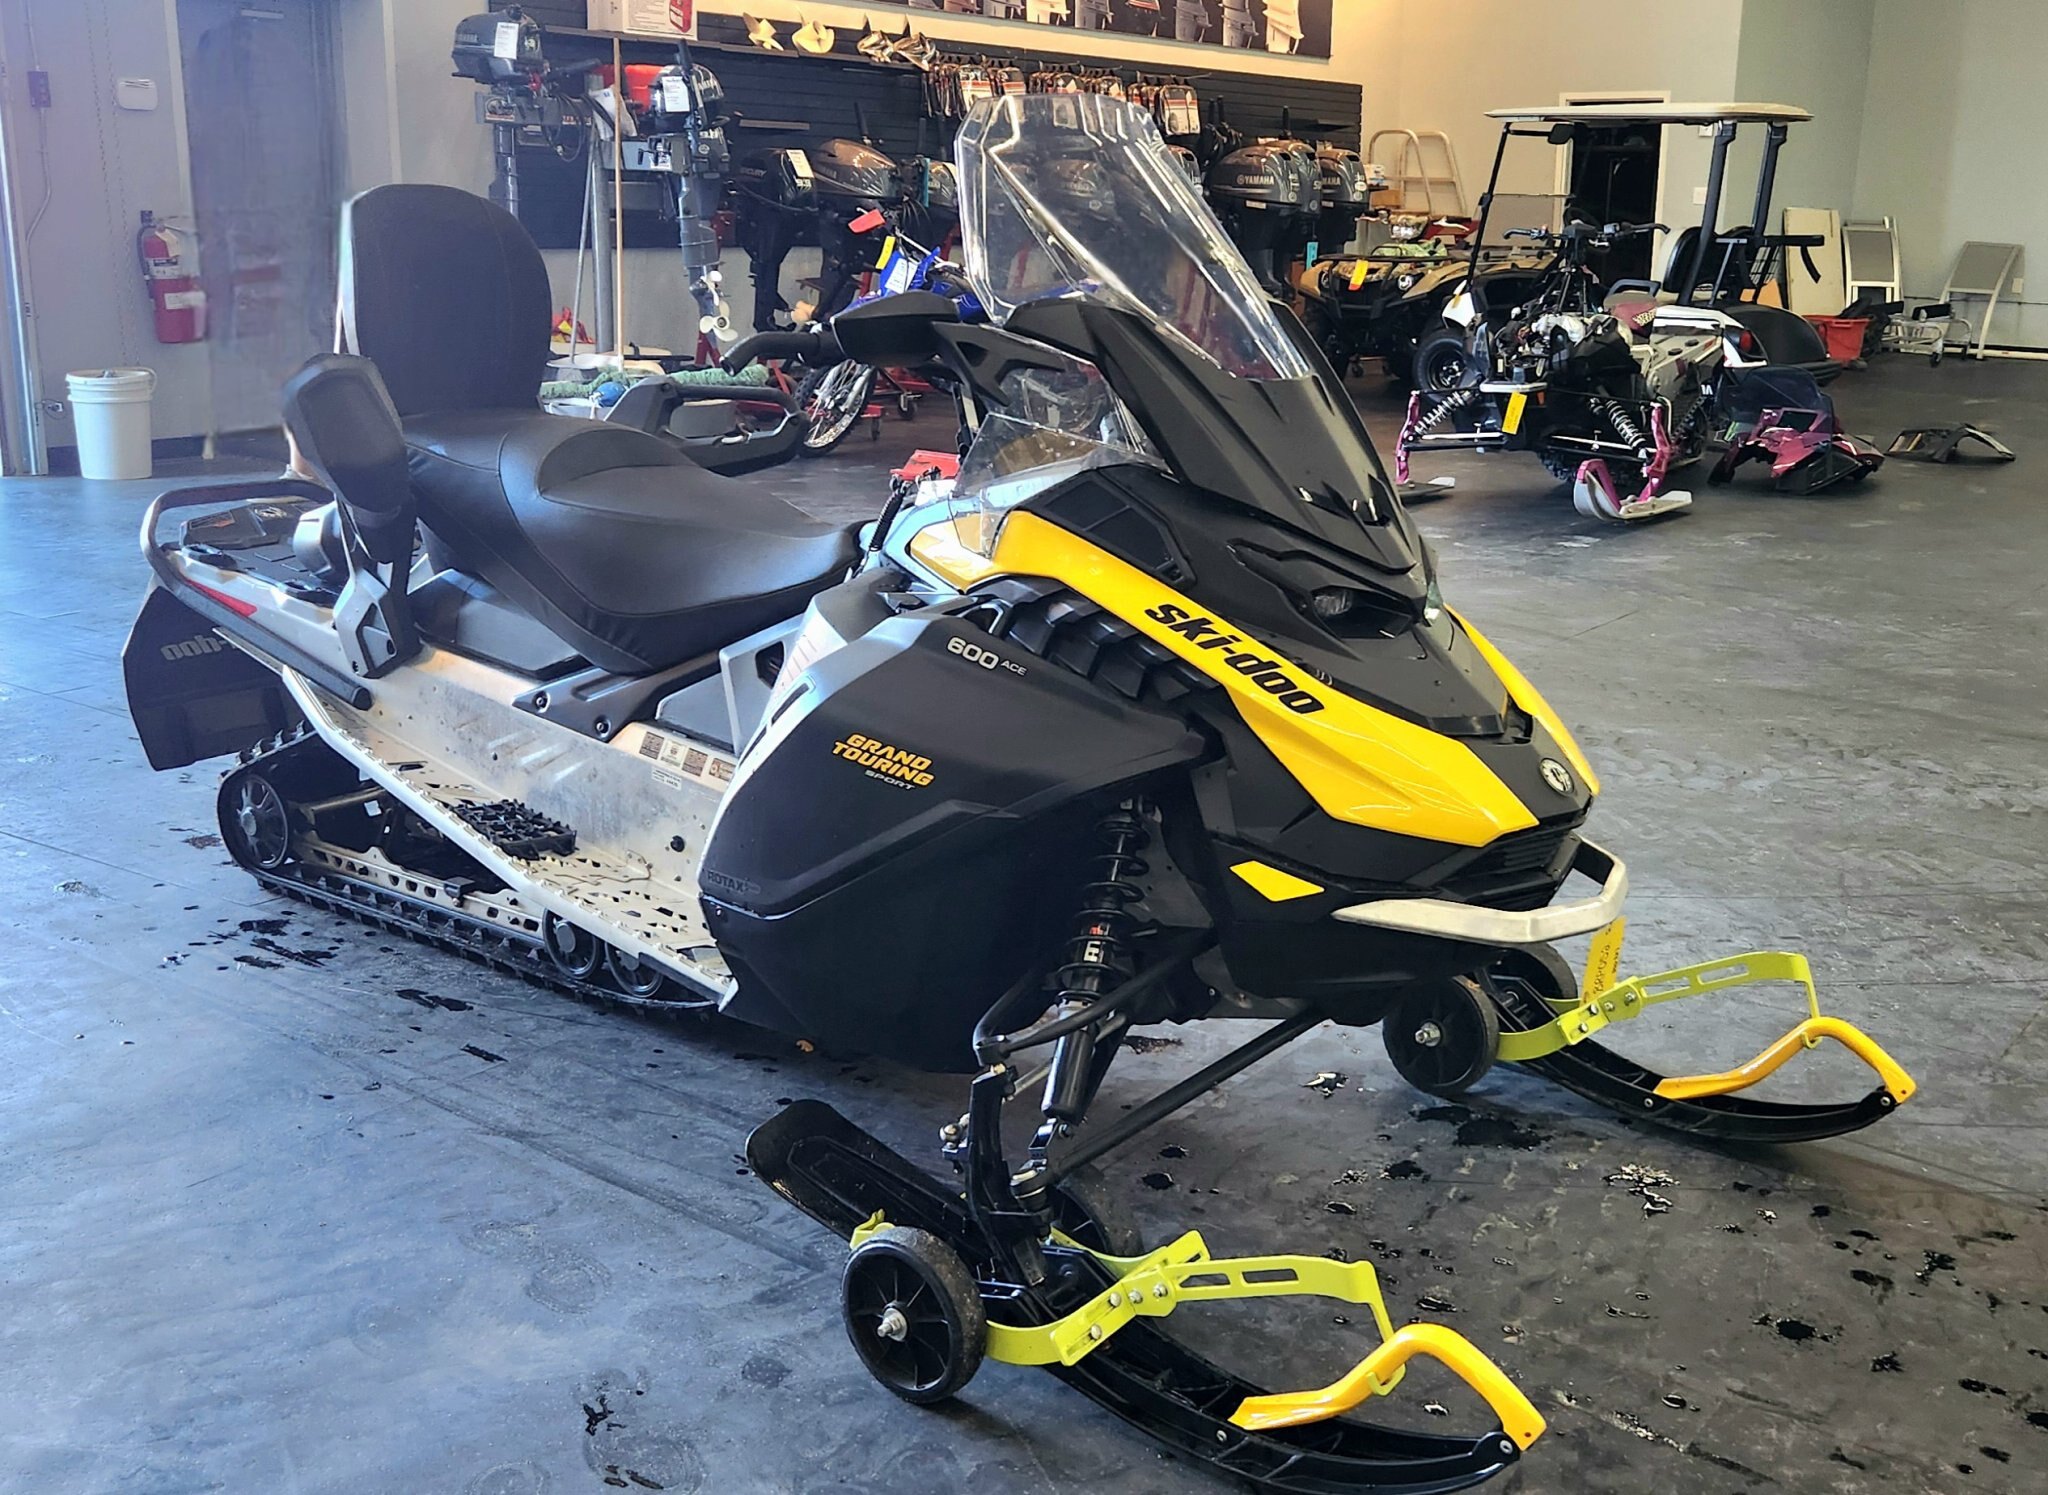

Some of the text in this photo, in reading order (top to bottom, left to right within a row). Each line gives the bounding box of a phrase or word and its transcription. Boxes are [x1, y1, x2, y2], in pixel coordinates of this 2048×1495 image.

[1244, 175, 1275, 186] YAMAHA
[947, 637, 1027, 676] 600 ACE
[1145, 604, 1325, 714] ski-doo
[833, 741, 935, 786] TOURING
[846, 734, 932, 771] GRAND
[865, 770, 915, 790] SPORT
[707, 870, 745, 893] ROTAX
